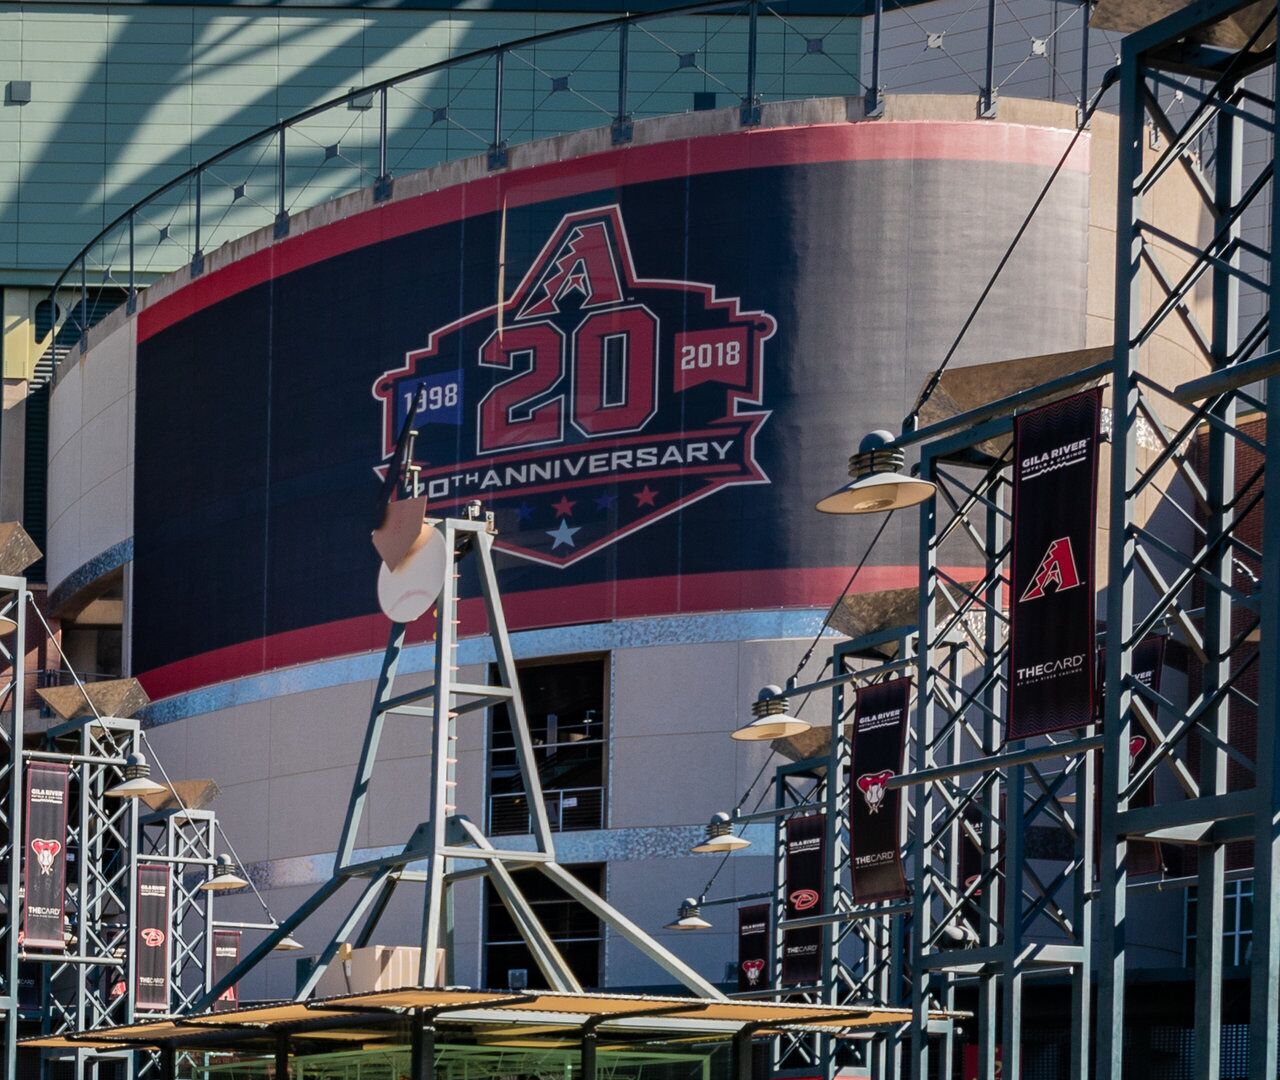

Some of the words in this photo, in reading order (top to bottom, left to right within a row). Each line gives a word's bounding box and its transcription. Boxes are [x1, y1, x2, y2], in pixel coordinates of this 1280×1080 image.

[680, 340, 741, 371] 2018
[476, 304, 661, 456] 20
[480, 440, 734, 489] ANNIVERSARY
[1022, 452, 1049, 468] GILA
[1051, 439, 1087, 459] RIVER
[1017, 655, 1083, 680] THECARD
[859, 715, 877, 724] GILA
[877, 709, 900, 720] RIVER
